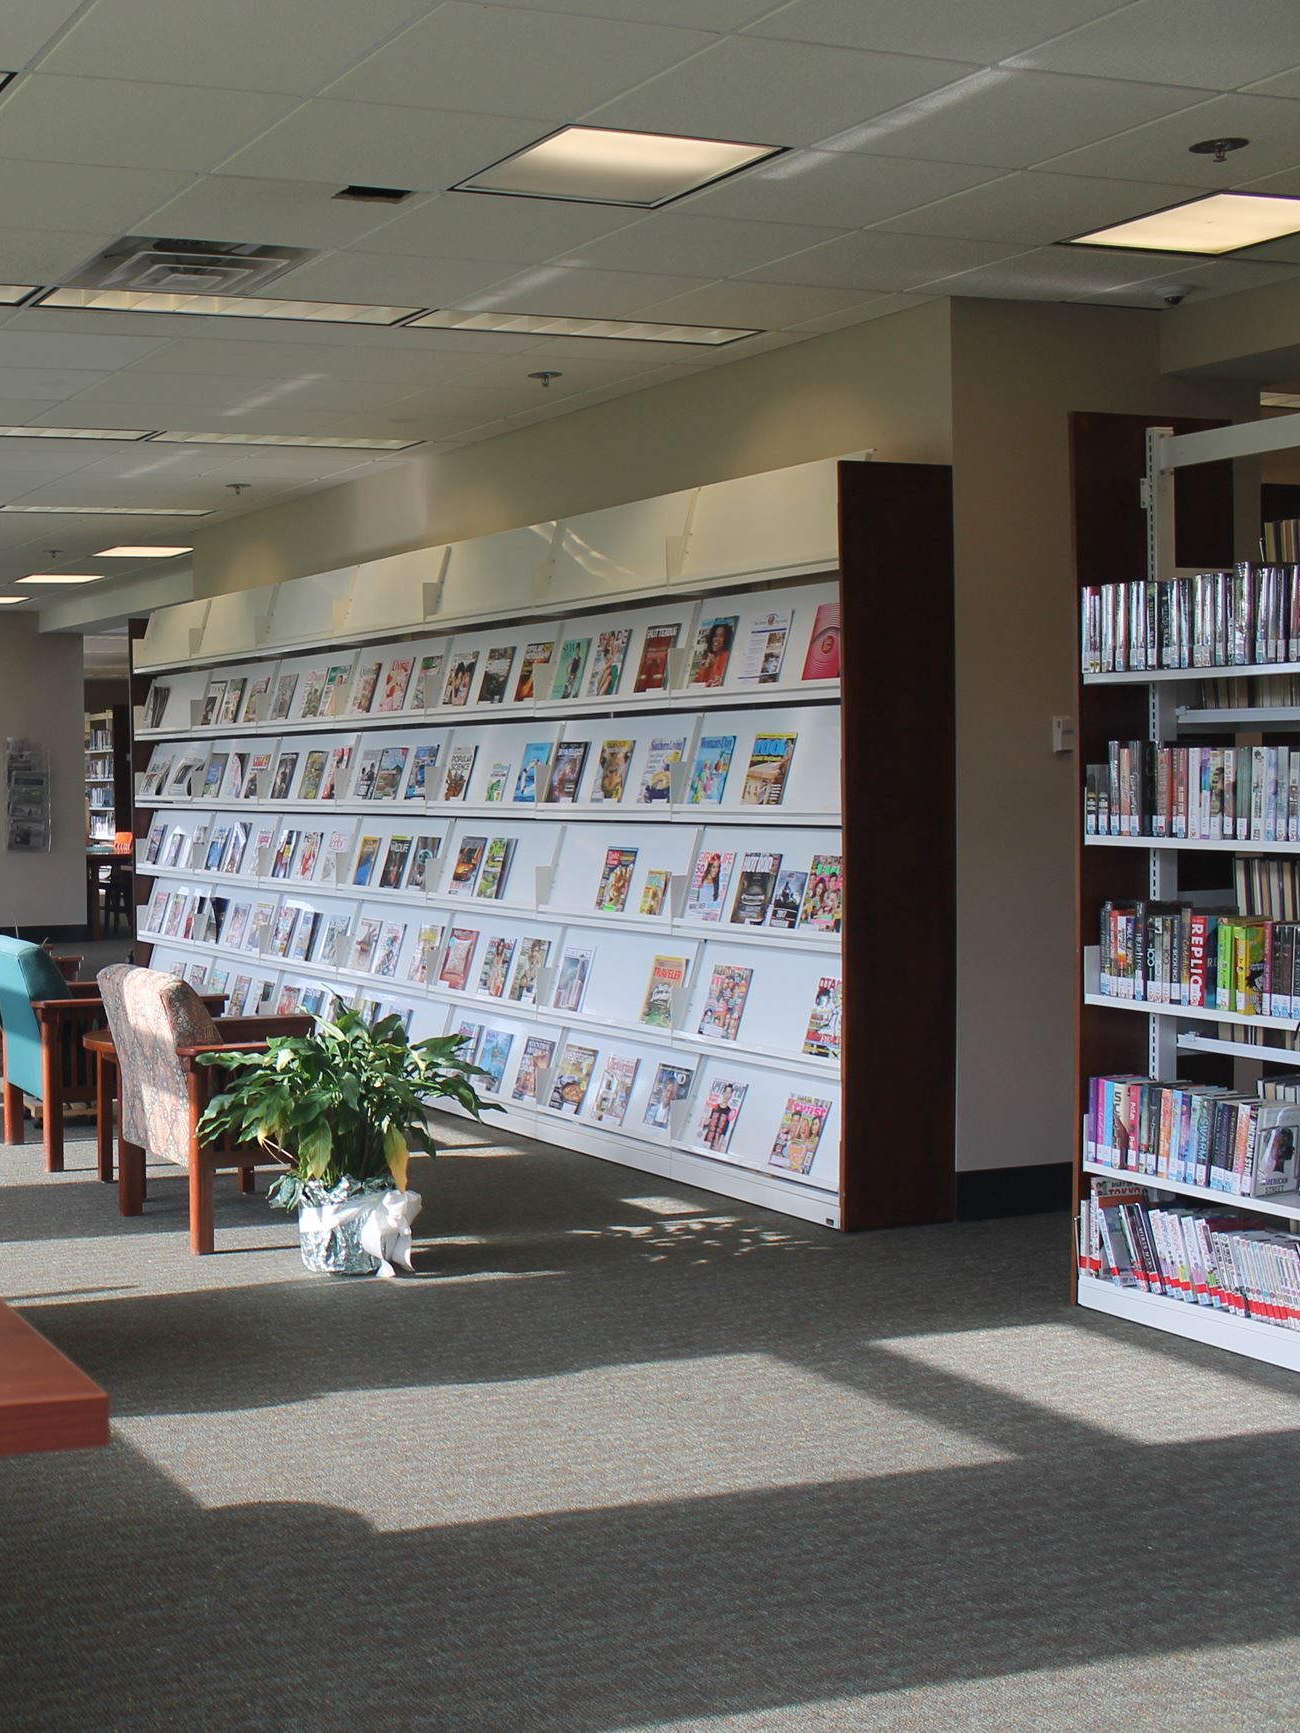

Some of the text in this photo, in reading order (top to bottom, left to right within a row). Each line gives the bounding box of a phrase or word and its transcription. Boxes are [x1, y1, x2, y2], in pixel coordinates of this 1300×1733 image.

[451, 754, 473, 763] POPULAR
[450, 762, 471, 771] SCIENCE
[1190, 923, 1204, 1003] REPLIC
[653, 966, 683, 980] TRAVELER
[1197, 1117, 1209, 1160] SWARM
[1245, 1119, 1257, 1158] AMERICAN
[1108, 1186, 1141, 1196] TOKYO
[1264, 1185, 1285, 1194] STREET
